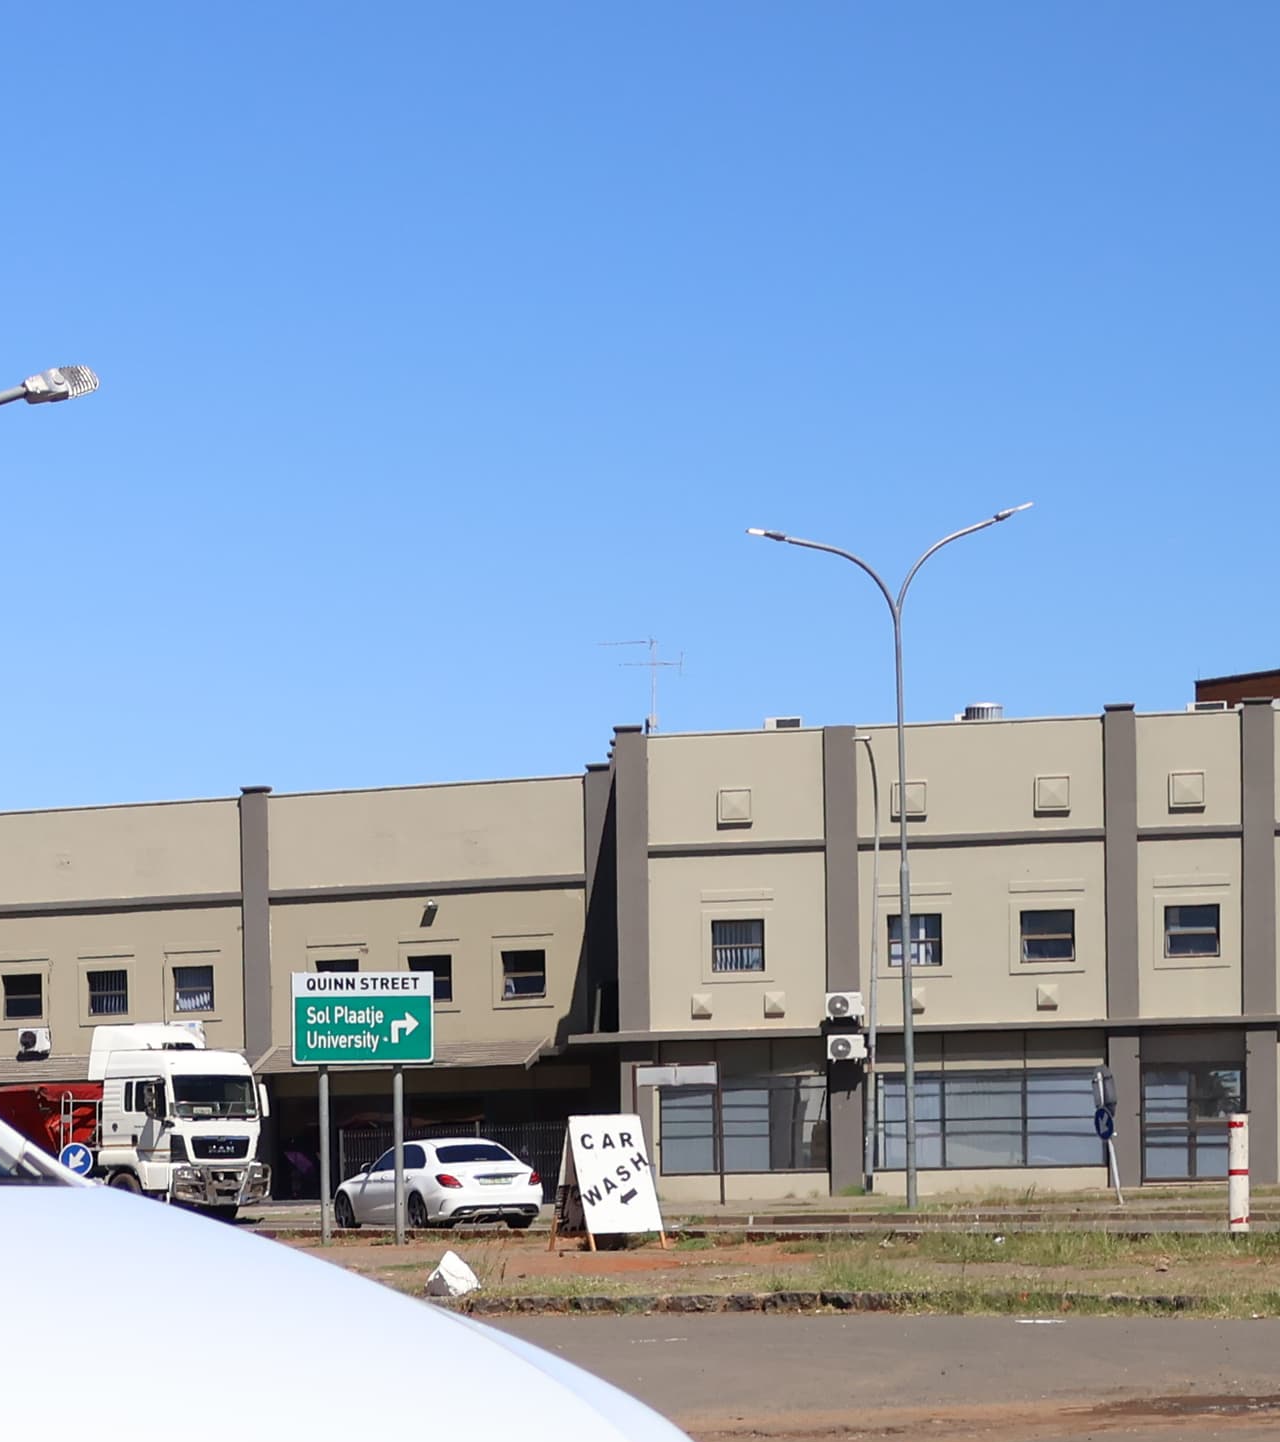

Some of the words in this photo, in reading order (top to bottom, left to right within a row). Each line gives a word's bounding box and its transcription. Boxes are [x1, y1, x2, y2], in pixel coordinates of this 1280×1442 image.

[306, 978, 356, 991] QUINN
[360, 977, 420, 990] STREET
[306, 1006, 330, 1025] Sol
[334, 1005, 384, 1028] Plaatje
[306, 1030, 379, 1053] University
[580, 1132, 634, 1150] CAR
[582, 1152, 648, 1207] WASH
